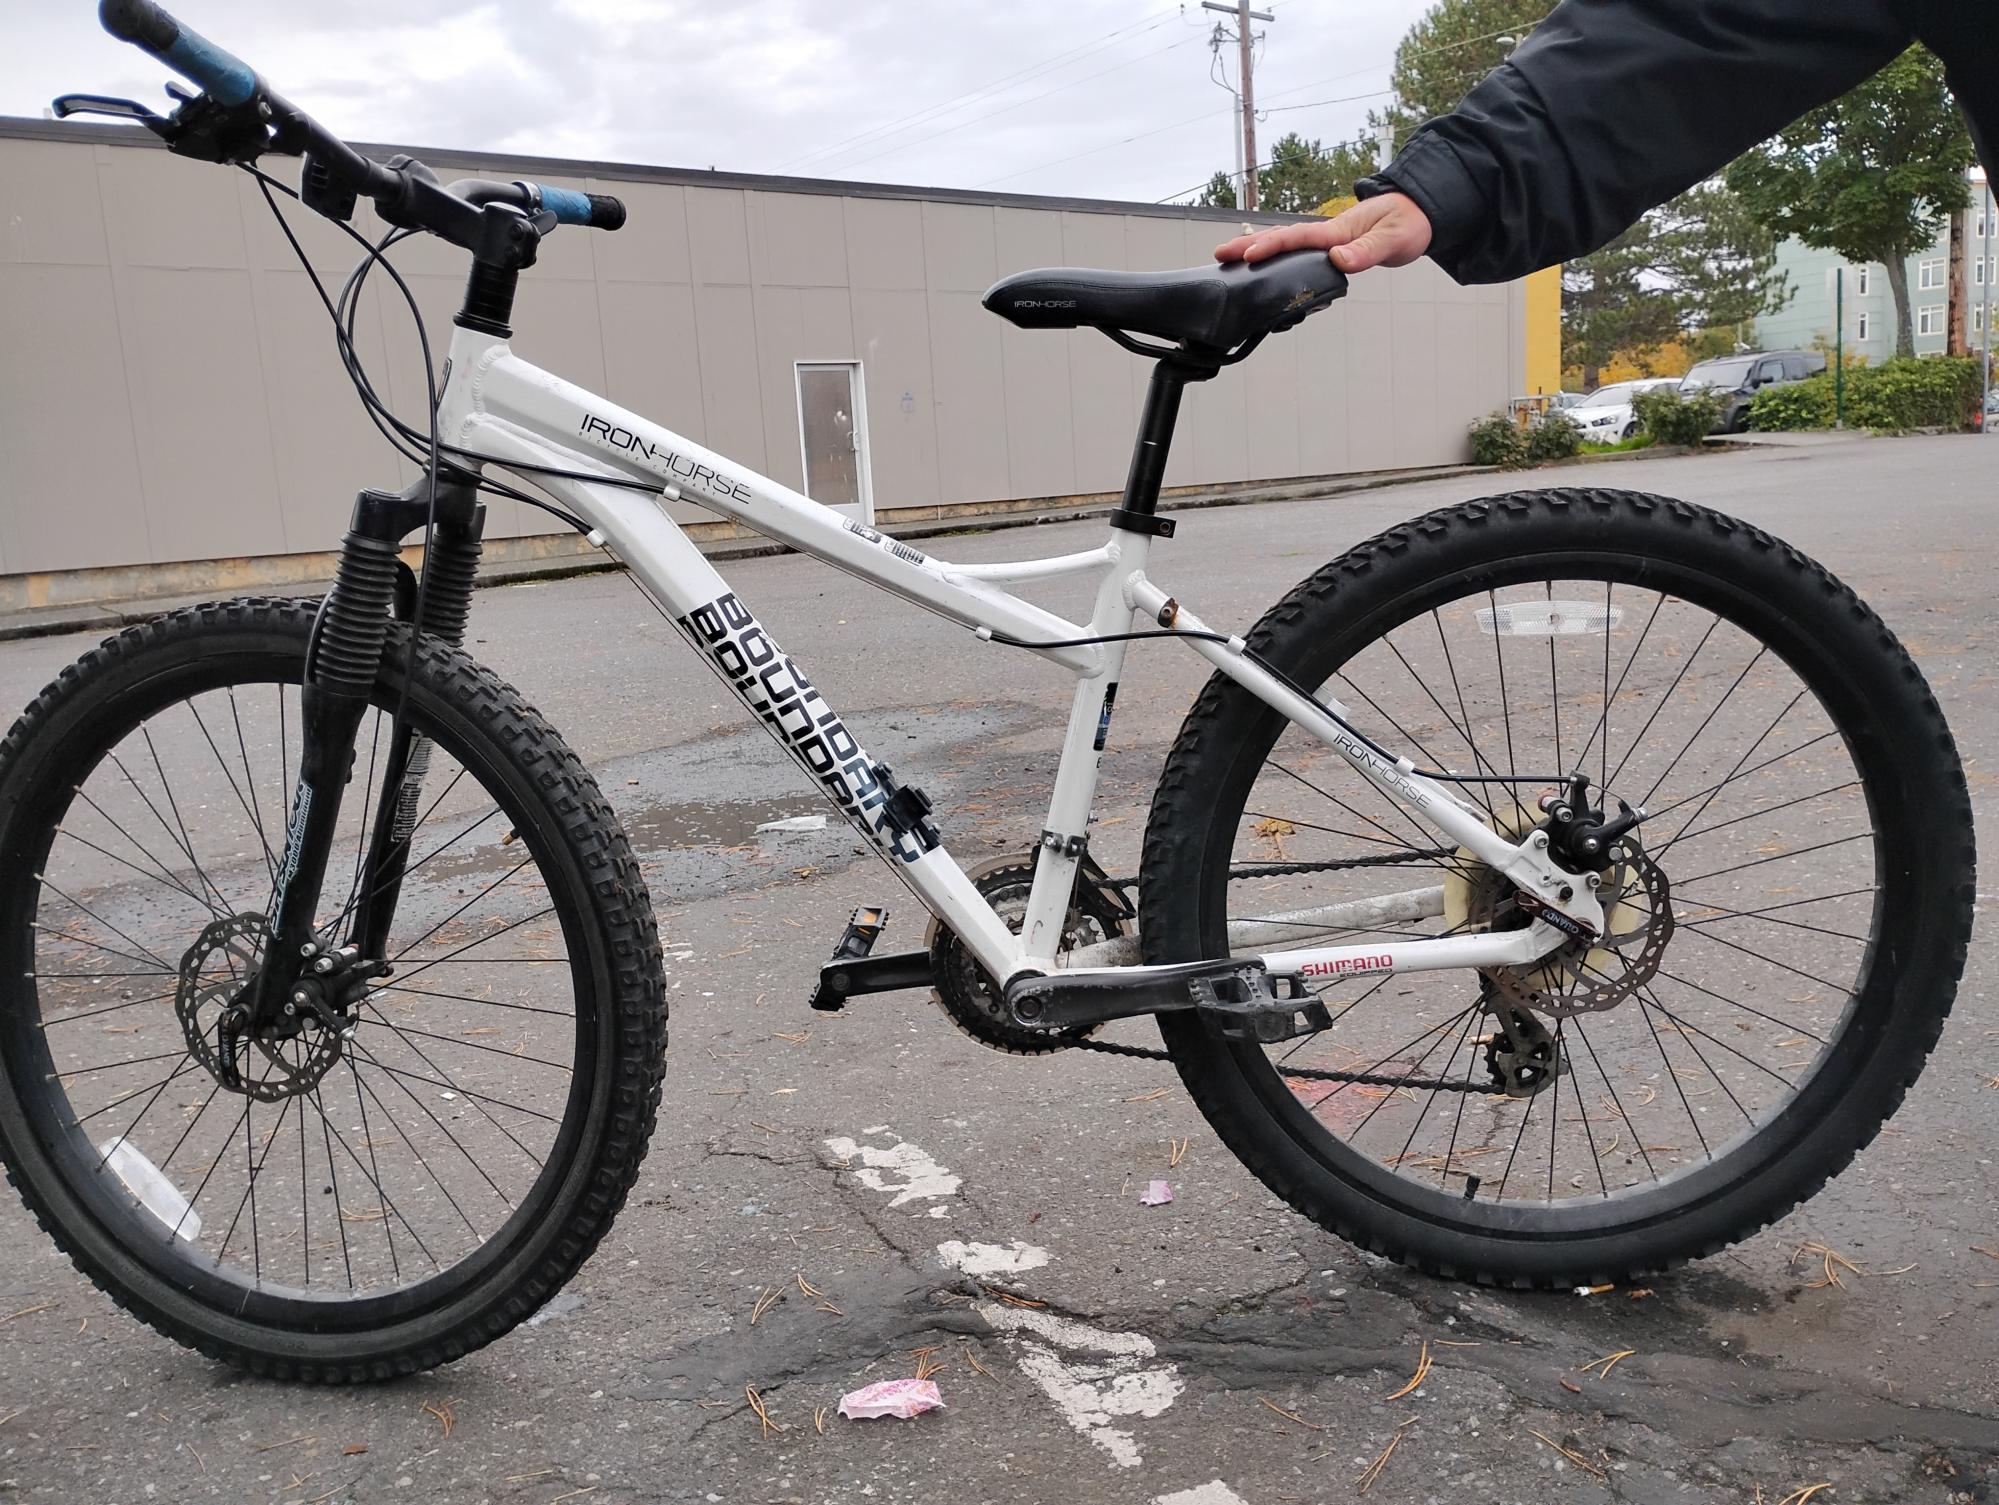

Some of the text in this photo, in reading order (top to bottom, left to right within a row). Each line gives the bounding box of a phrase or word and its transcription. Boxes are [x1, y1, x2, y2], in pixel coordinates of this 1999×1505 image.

[1014, 300, 1077, 308] IRONHORSE
[581, 414, 751, 504] IRONHORSE
[716, 592, 898, 866] BOUNDA
[1333, 733, 1432, 809] IRONHORSE
[1302, 954, 1393, 976] SHIMANO
